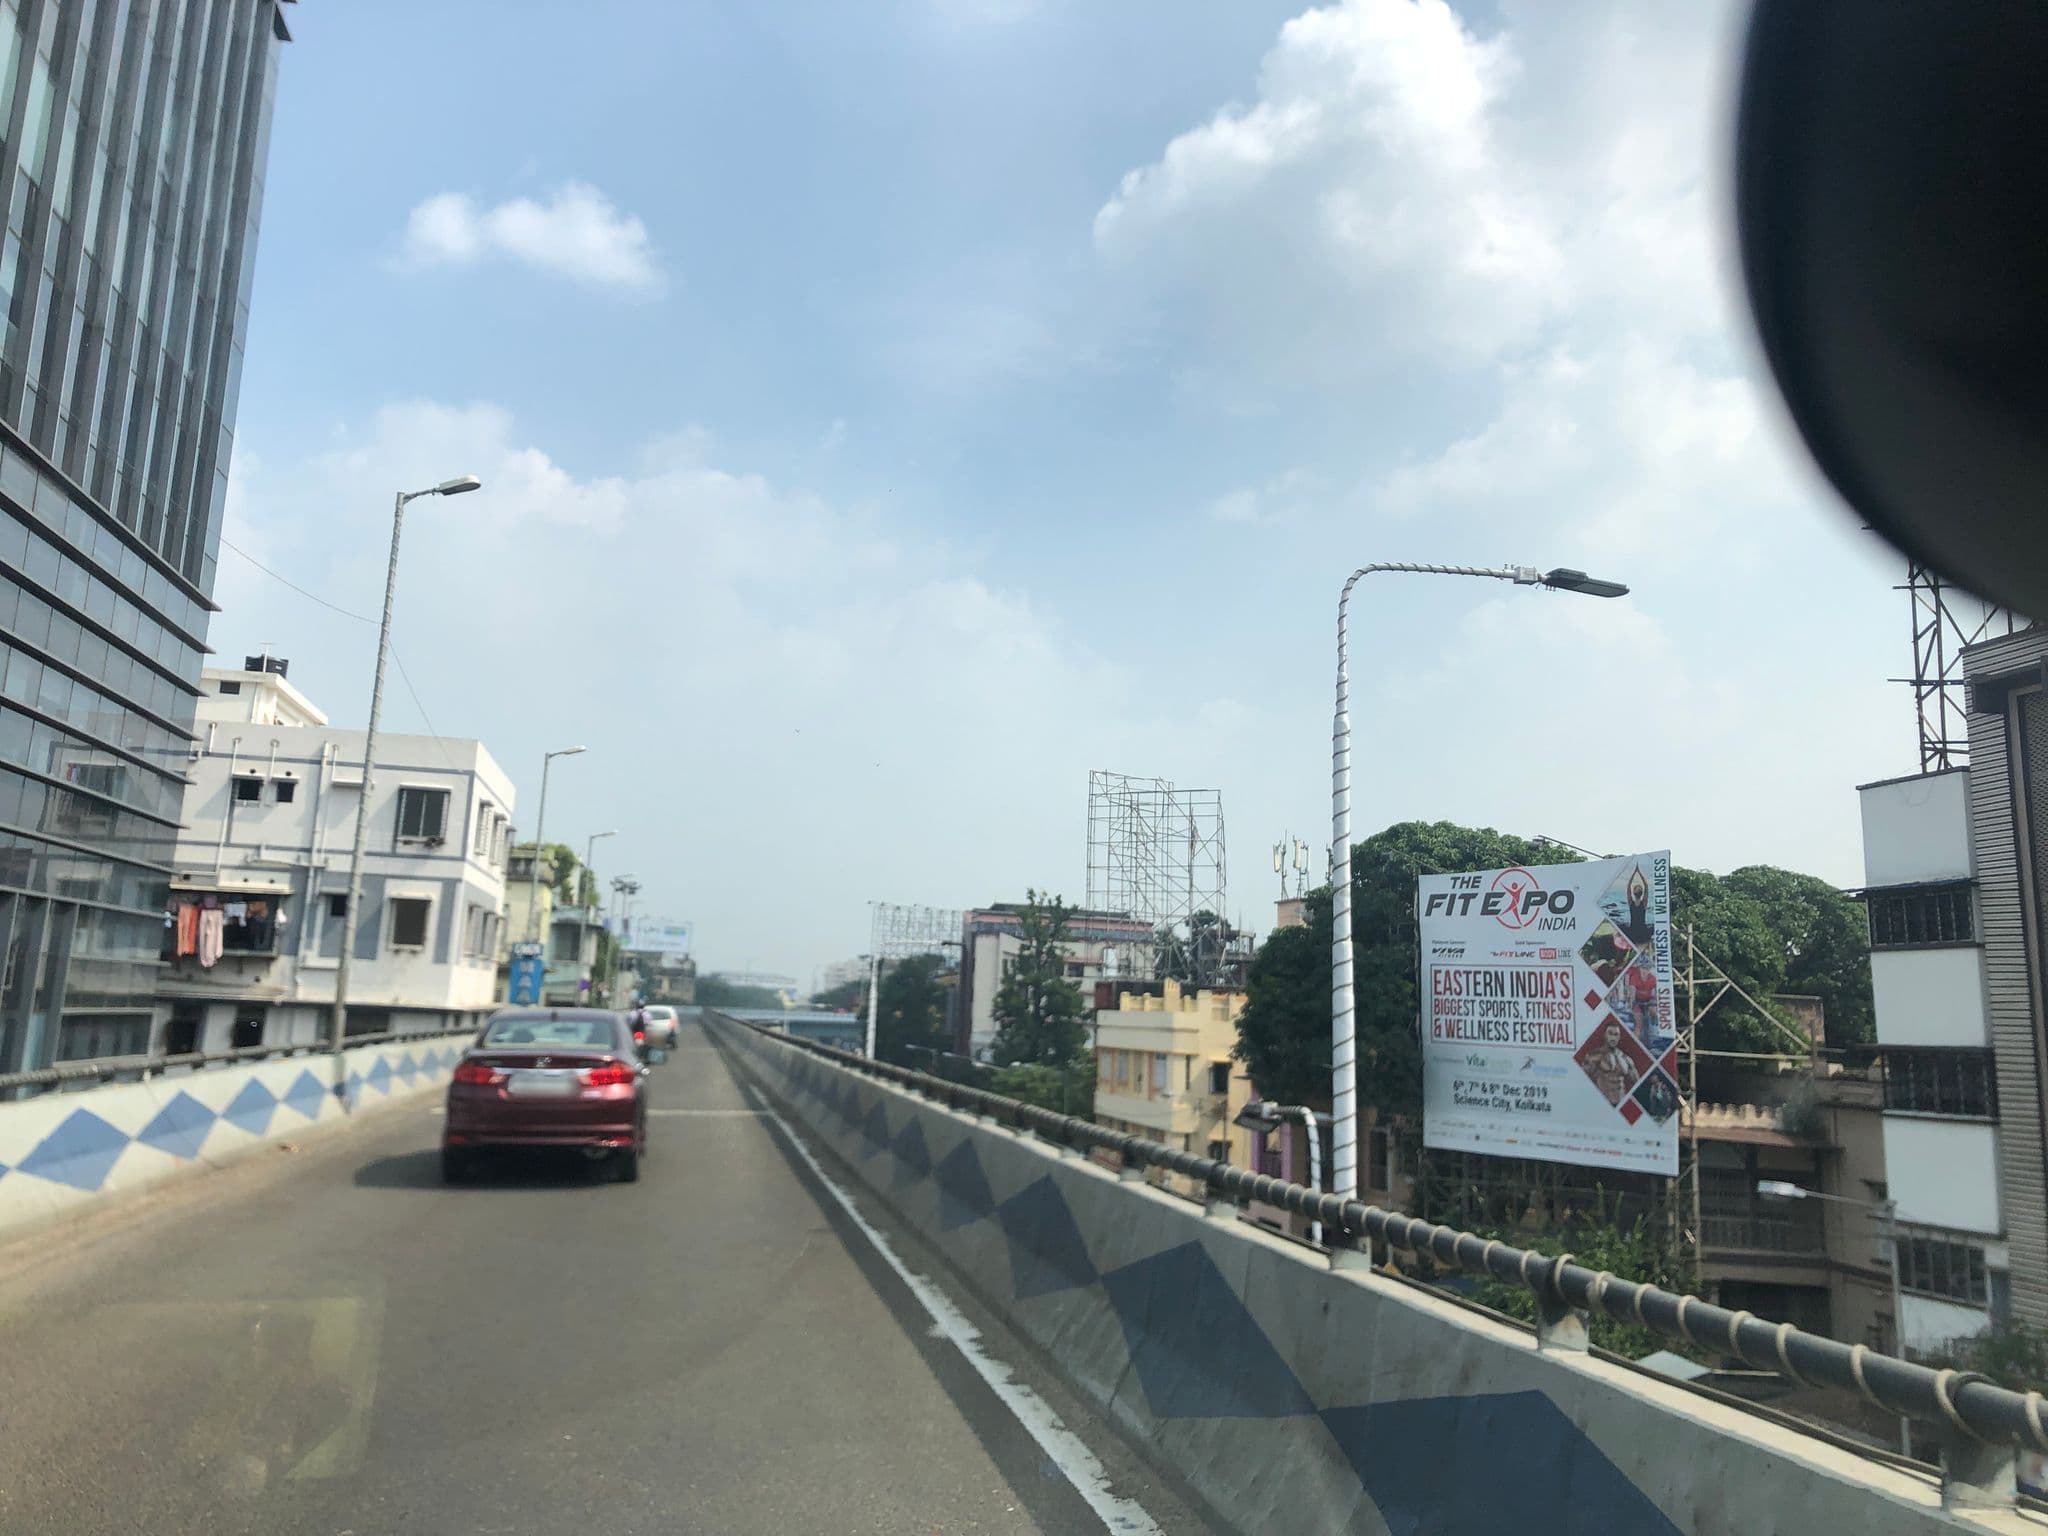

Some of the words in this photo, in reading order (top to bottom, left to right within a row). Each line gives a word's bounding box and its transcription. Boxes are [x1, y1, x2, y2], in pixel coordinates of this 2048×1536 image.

[1450, 876, 1482, 889] THE
[1654, 858, 1668, 915] WELLNESS
[1425, 893, 1478, 917] FIT
[1538, 917, 1577, 931] INDIA
[1656, 929, 1669, 973] FITNESS
[1434, 970, 1505, 998] EASTERN
[1510, 971, 1571, 999] INDIA'S
[1433, 998, 1476, 1016] BIGGEST
[1479, 999, 1524, 1020] SPORTS,
[1526, 1001, 1572, 1020] FITNESS
[1658, 988, 1672, 1030] SPORTS
[1433, 1018, 1442, 1038] &
[1445, 1018, 1510, 1042] WELLNESS
[1513, 1022, 1573, 1045] FESTIVAL
[1481, 1082, 1488, 1094] &
[1503, 1084, 1521, 1097] Dec
[1523, 1085, 1549, 1098] 2019
[1453, 1093, 1490, 1107] Science
[1515, 1099, 1552, 1113] Kolkata
